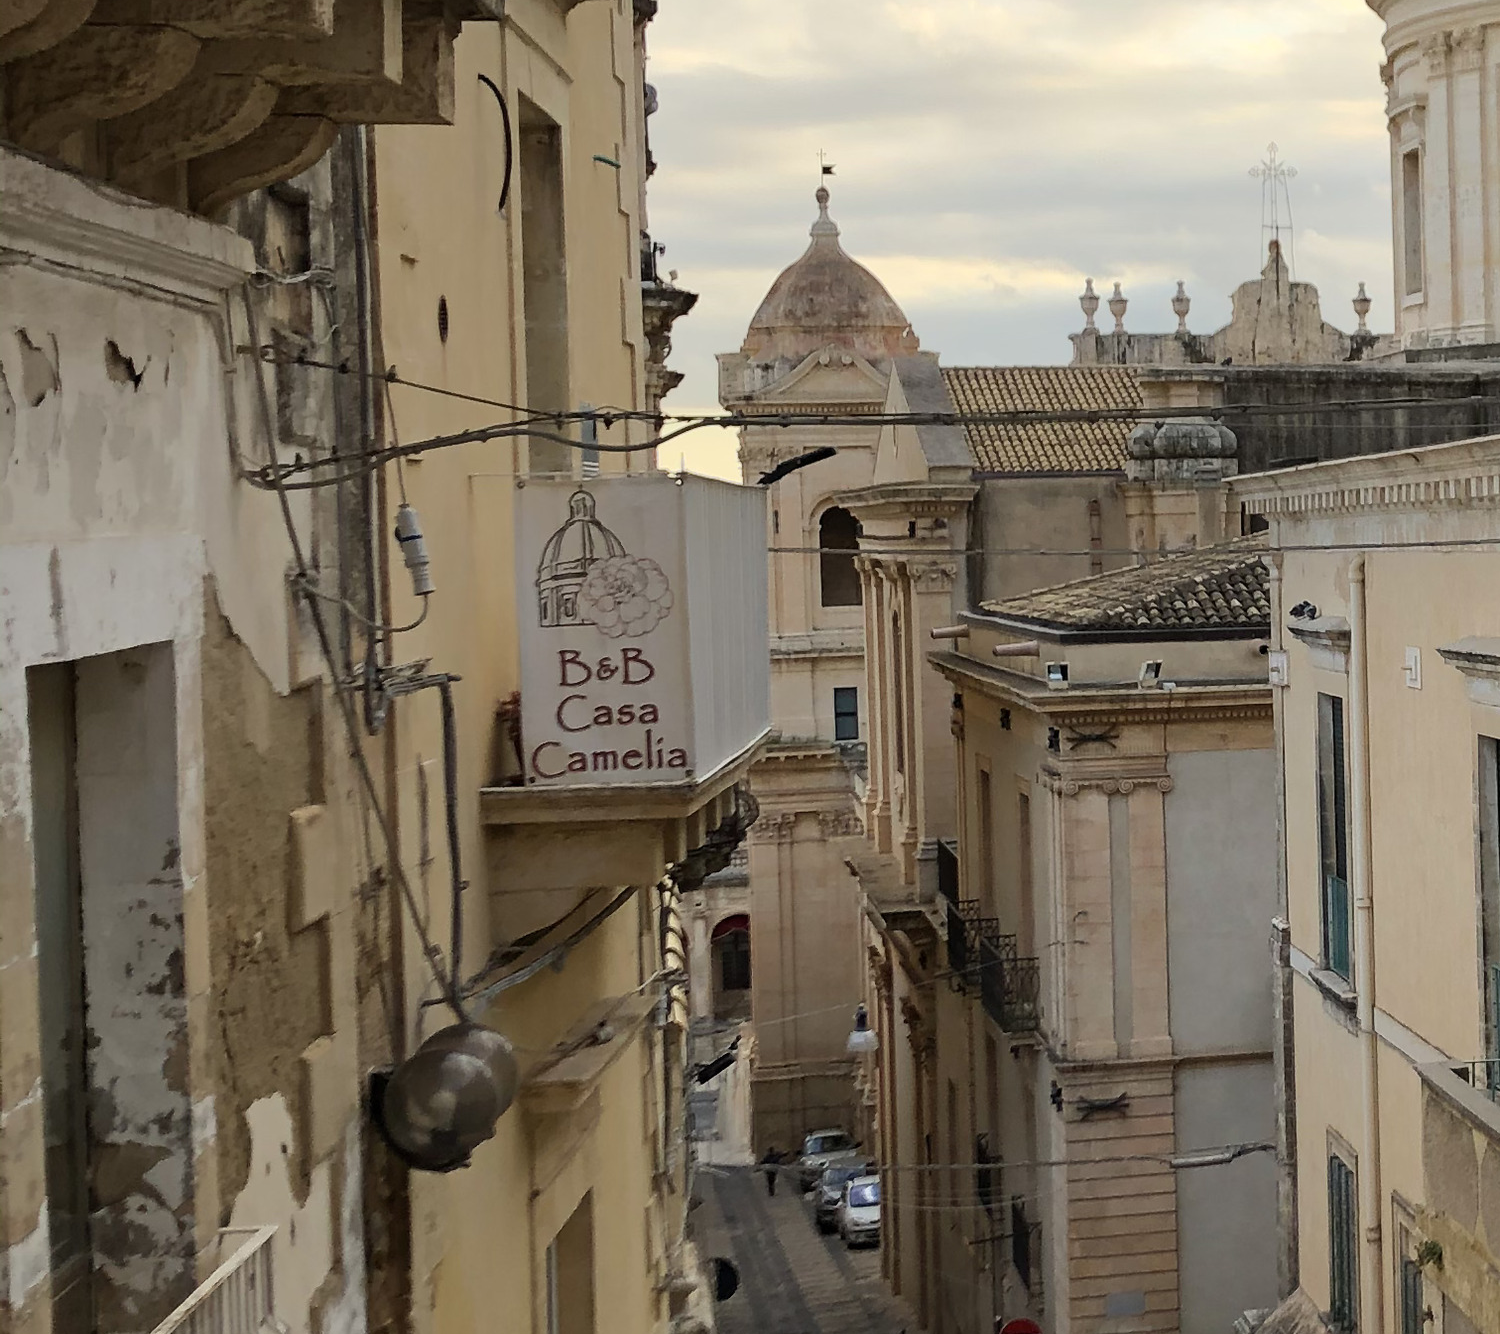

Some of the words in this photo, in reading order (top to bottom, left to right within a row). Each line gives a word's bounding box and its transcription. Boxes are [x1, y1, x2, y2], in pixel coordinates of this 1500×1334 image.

[557, 648, 656, 687] B&B
[556, 694, 660, 732] Casa
[532, 730, 688, 779] Camelia
